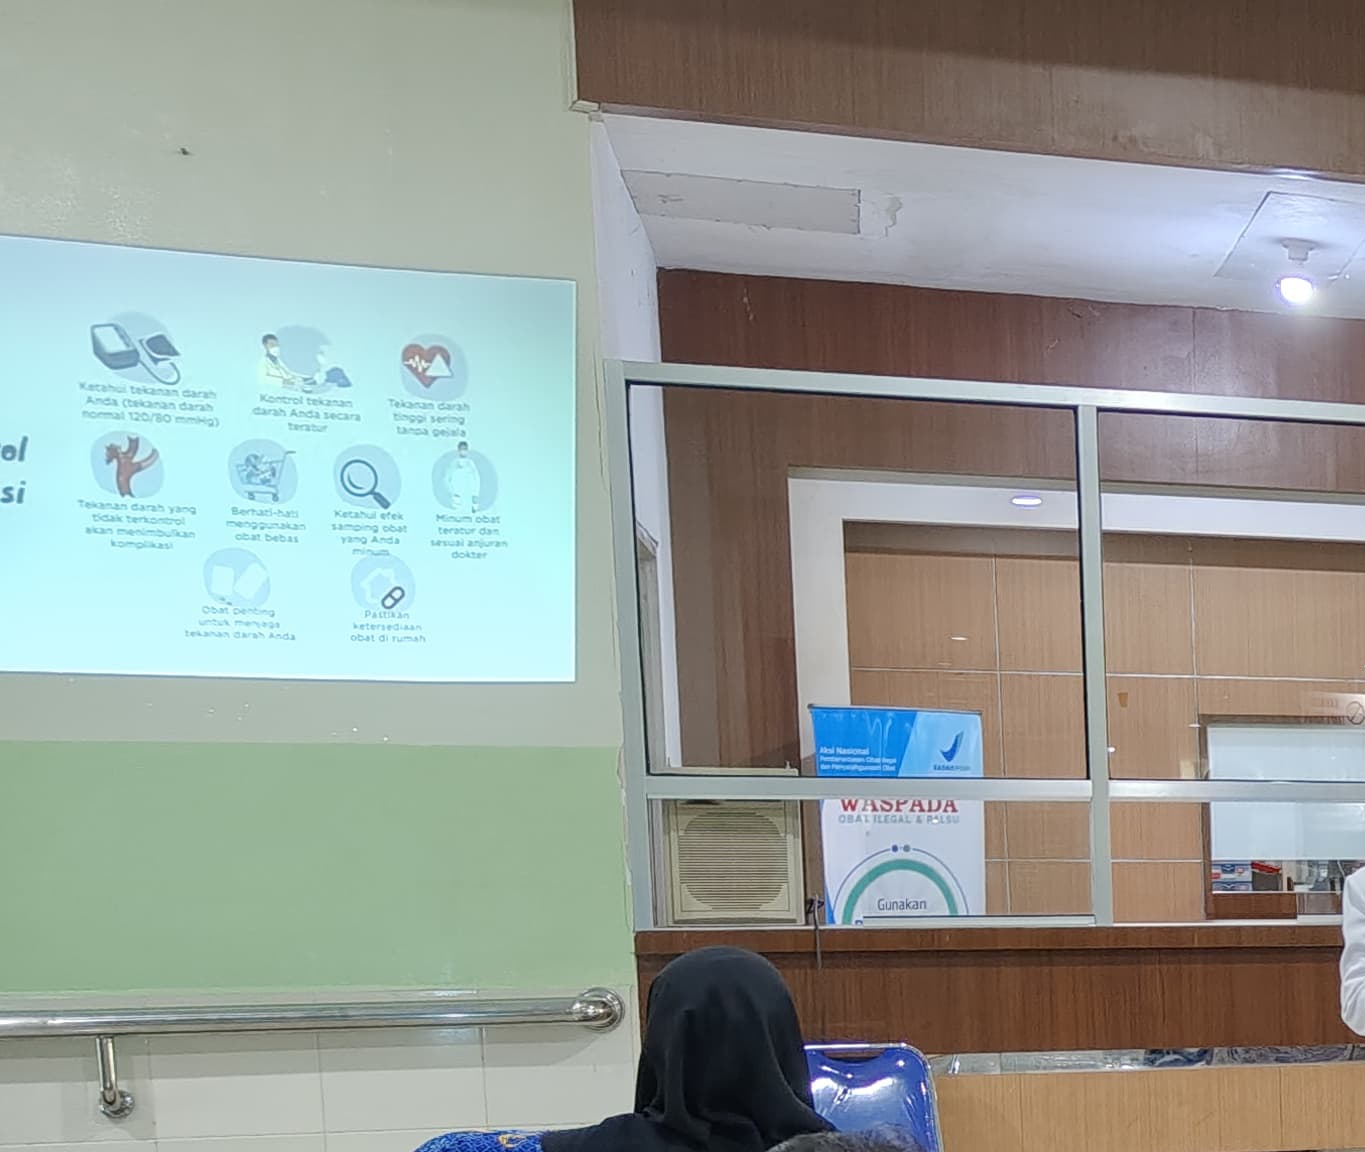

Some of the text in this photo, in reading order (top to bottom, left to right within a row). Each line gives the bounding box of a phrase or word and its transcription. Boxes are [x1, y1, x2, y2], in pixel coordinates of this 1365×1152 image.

[86, 395, 119, 406] Anda
[259, 394, 303, 406] Kontrol
[387, 398, 435, 410] Tekanan
[289, 408, 321, 420] Anda
[0, 435, 29, 462] ol
[840, 800, 959, 813] WASPADA
[838, 814, 870, 824] OBAT
[873, 814, 913, 825] ILEGAL
[877, 898, 928, 912] Gunakan
